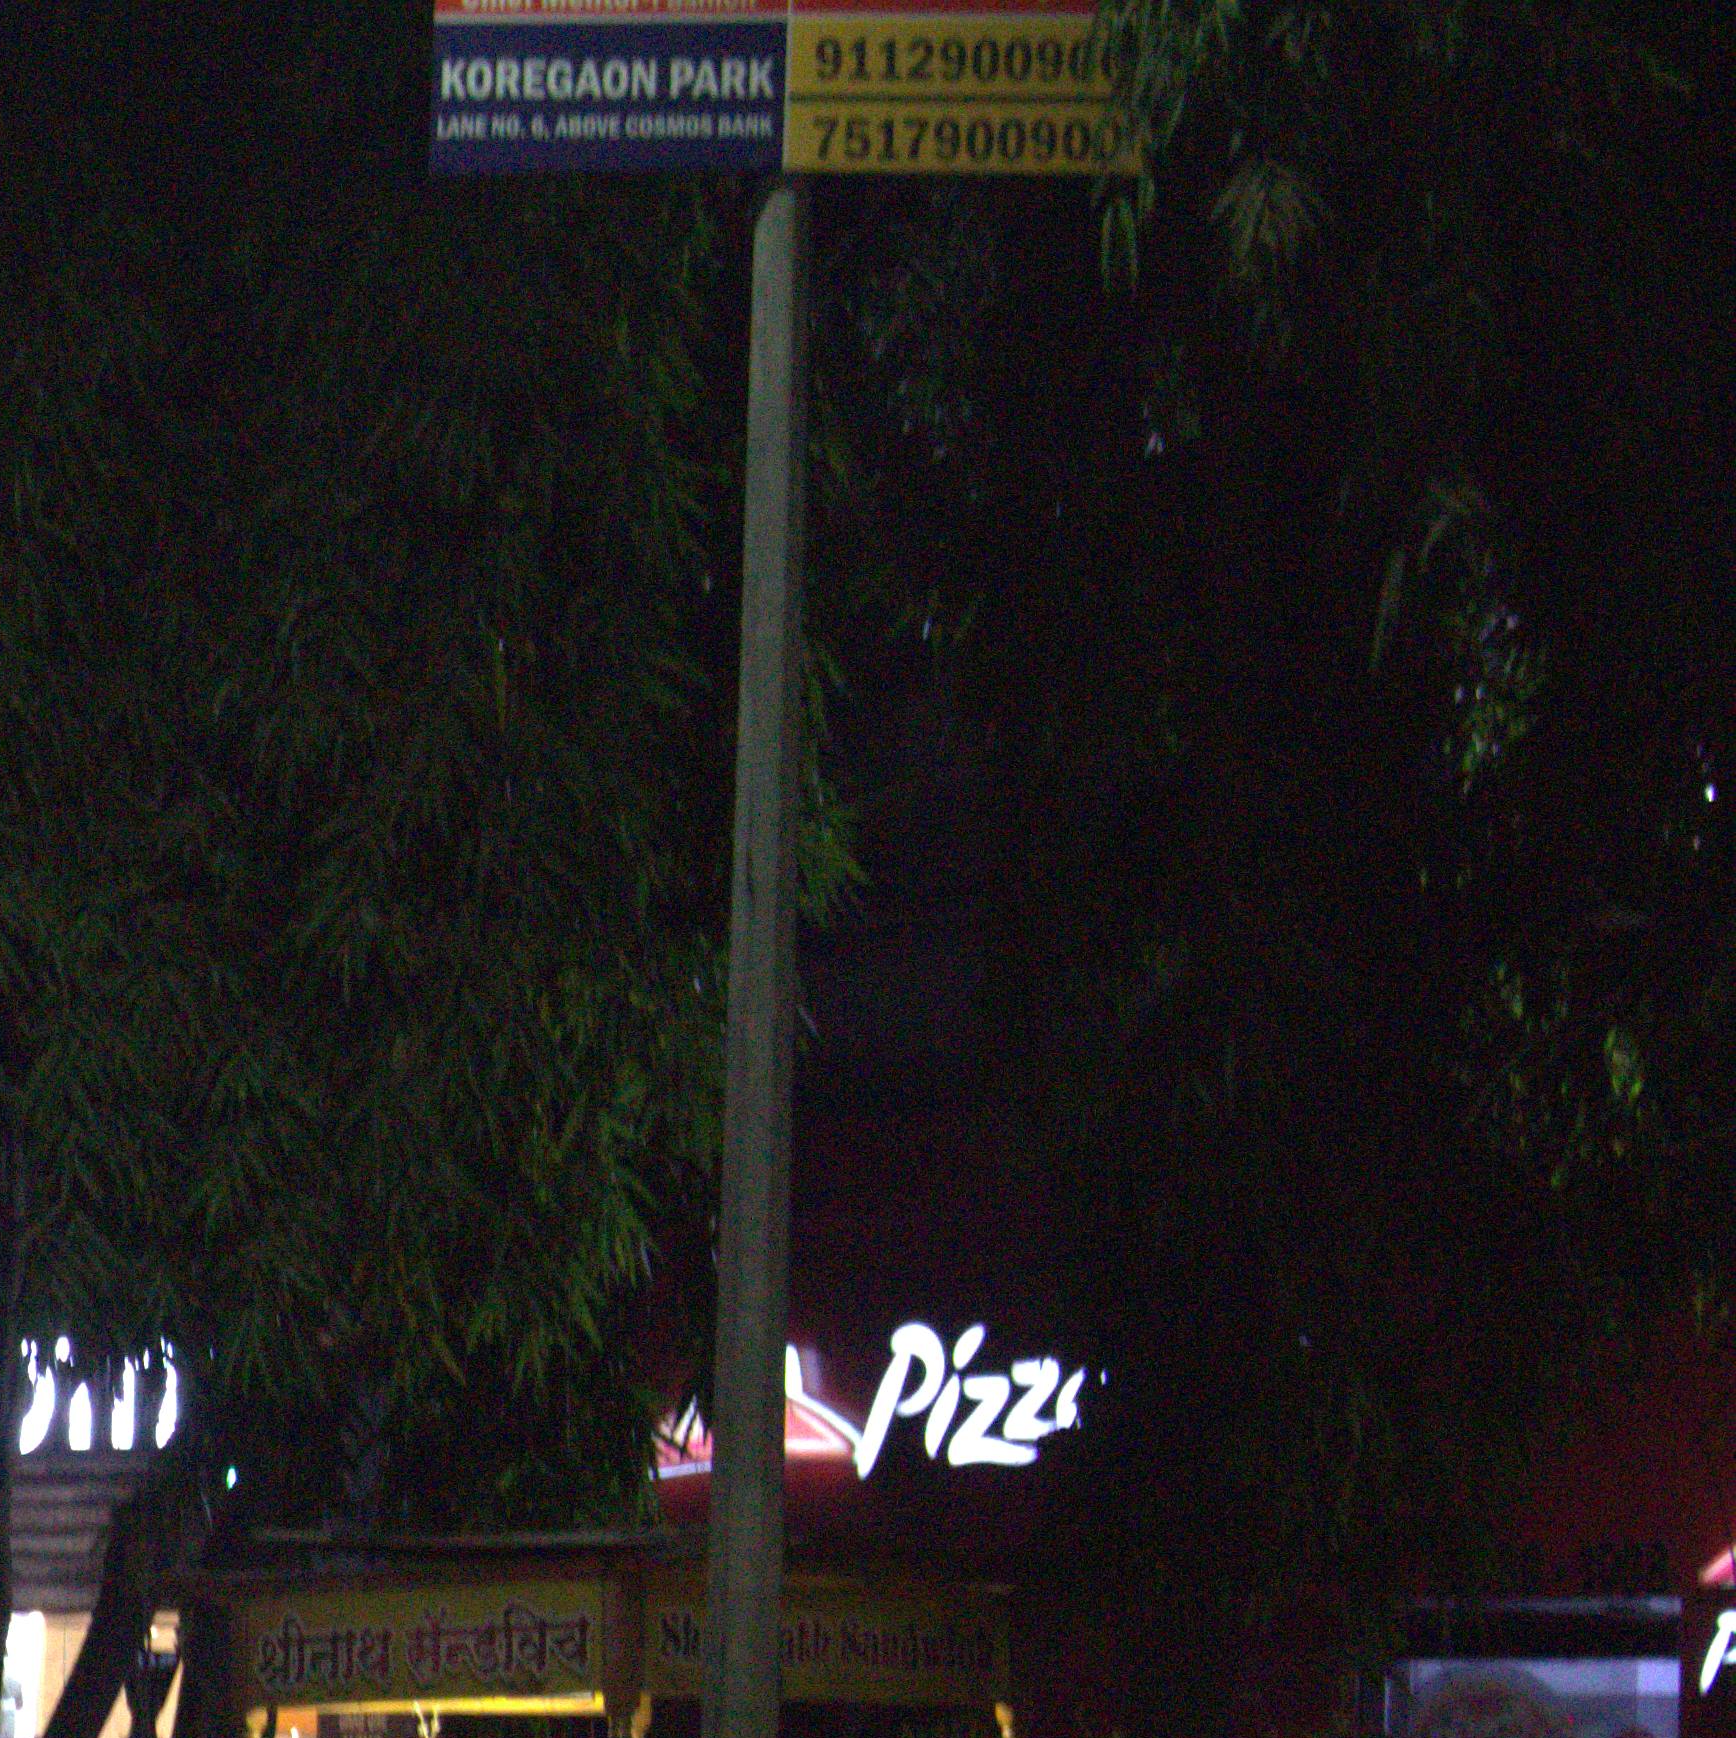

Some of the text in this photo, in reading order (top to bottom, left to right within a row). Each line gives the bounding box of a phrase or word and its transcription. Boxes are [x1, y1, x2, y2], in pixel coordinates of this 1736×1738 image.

[440, 58, 775, 101] KOREGAON PARK
[436, 113, 487, 140] LANE
[491, 113, 526, 140] NO.
[554, 113, 619, 140] ABOVE
[624, 113, 713, 140] COSMOS
[717, 113, 775, 140] BANK
